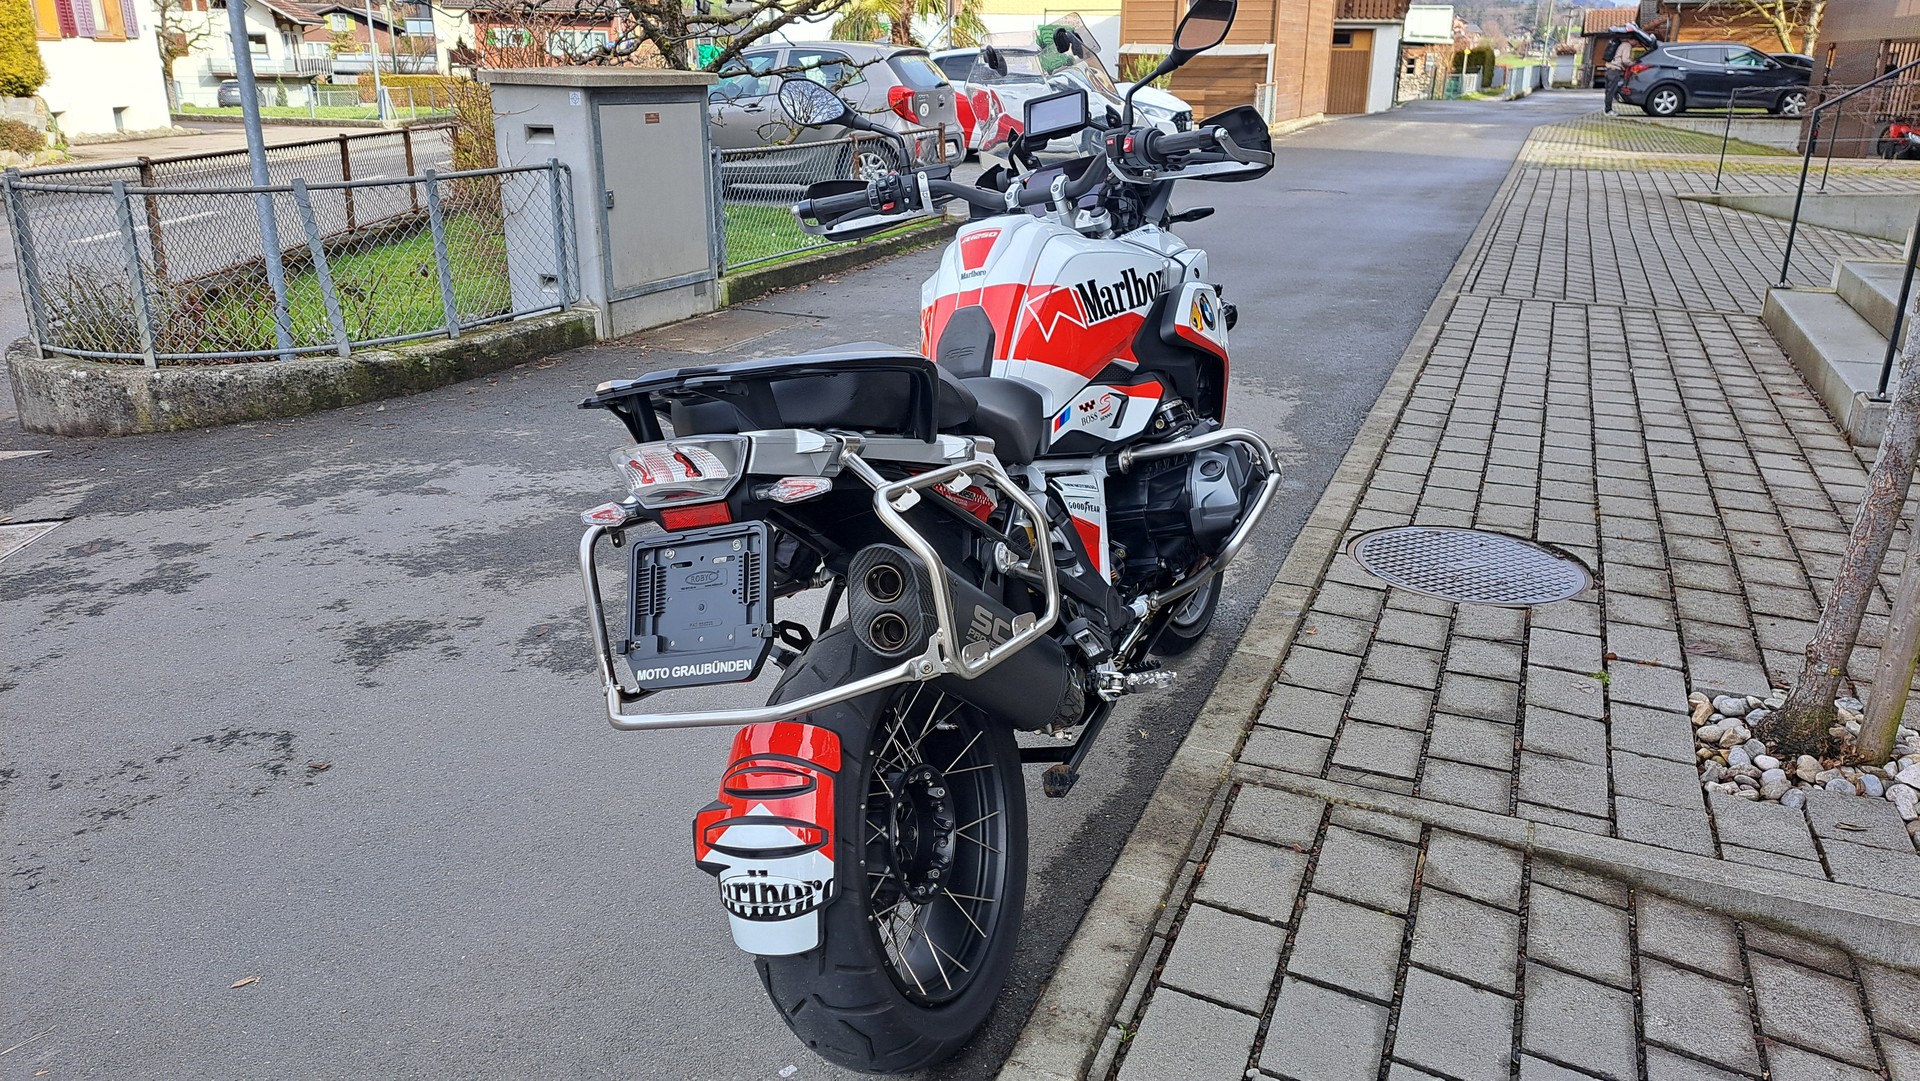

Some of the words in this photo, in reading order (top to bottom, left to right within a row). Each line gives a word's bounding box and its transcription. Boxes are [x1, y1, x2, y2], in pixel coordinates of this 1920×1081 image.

[960, 269, 987, 280] Marlboro
[1081, 412, 1099, 426] BOSS
[1069, 501, 1100, 513] GOODYEAR
[637, 667, 669, 681] MOTO
[672, 659, 752, 678] GRAUBÜNDEN
